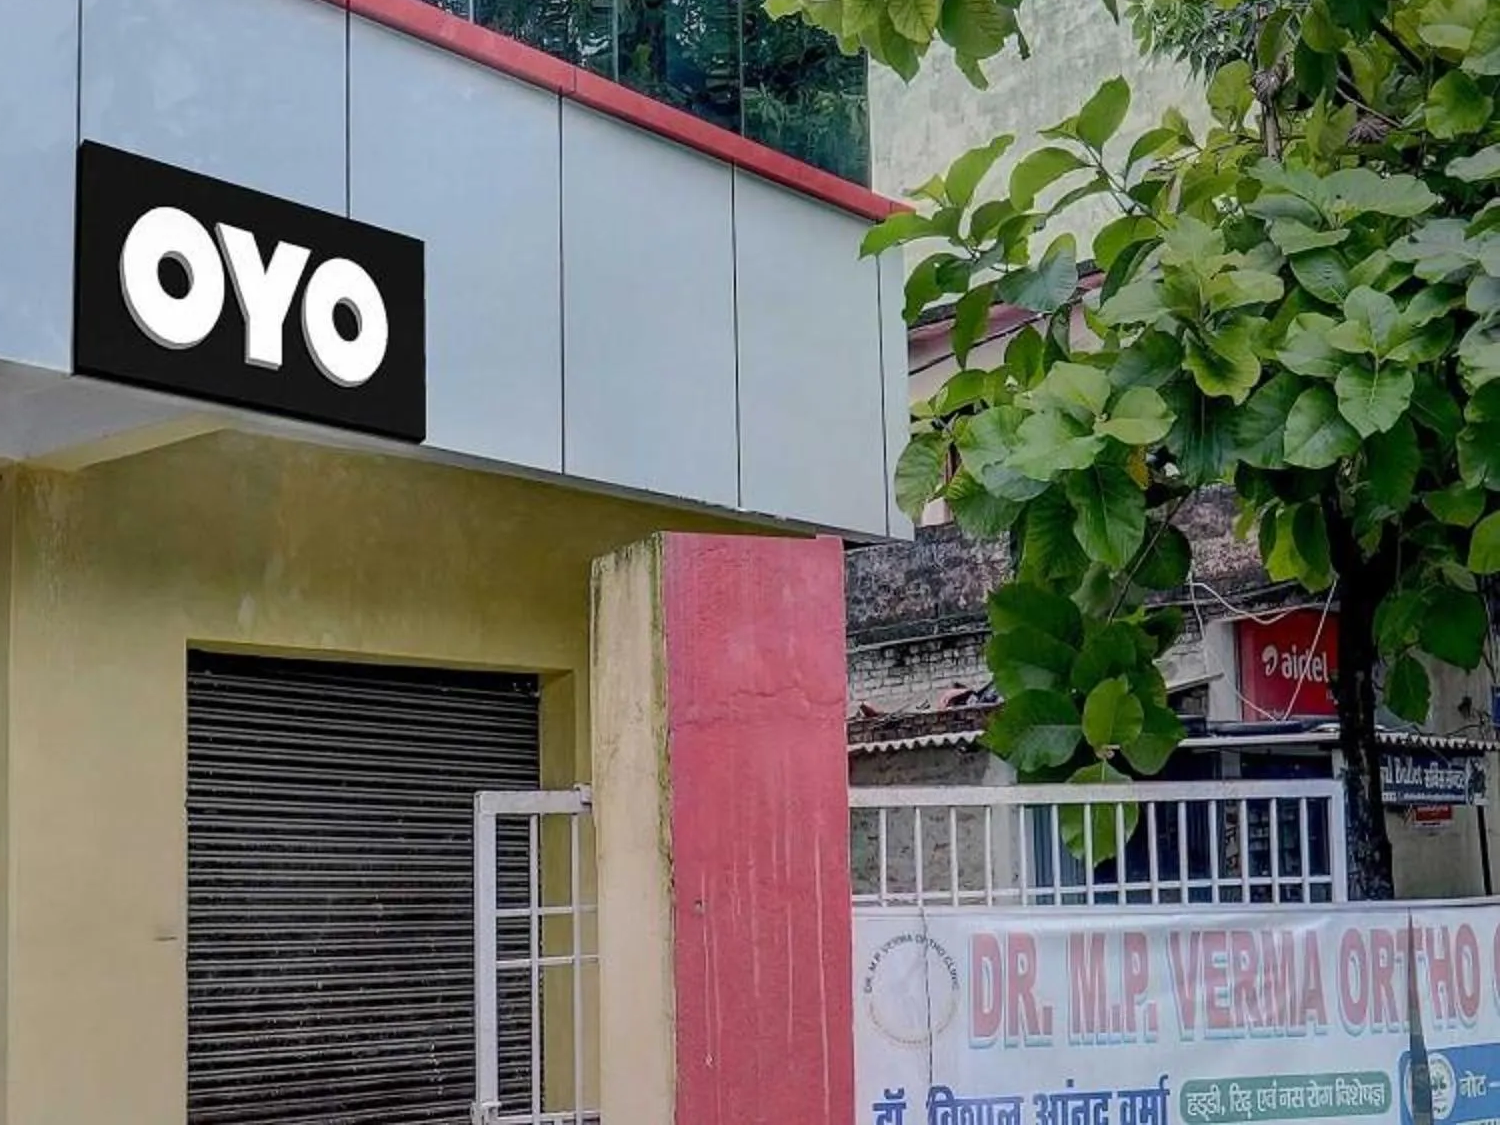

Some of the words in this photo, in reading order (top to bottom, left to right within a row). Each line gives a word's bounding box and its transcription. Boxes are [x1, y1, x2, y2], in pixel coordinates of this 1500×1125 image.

[119, 206, 389, 388] OYO
[1281, 644, 1329, 683] airtel
[969, 931, 1053, 1049] DR.
[1066, 931, 1158, 1047] M.P.
[1166, 929, 1328, 1043] VERMA
